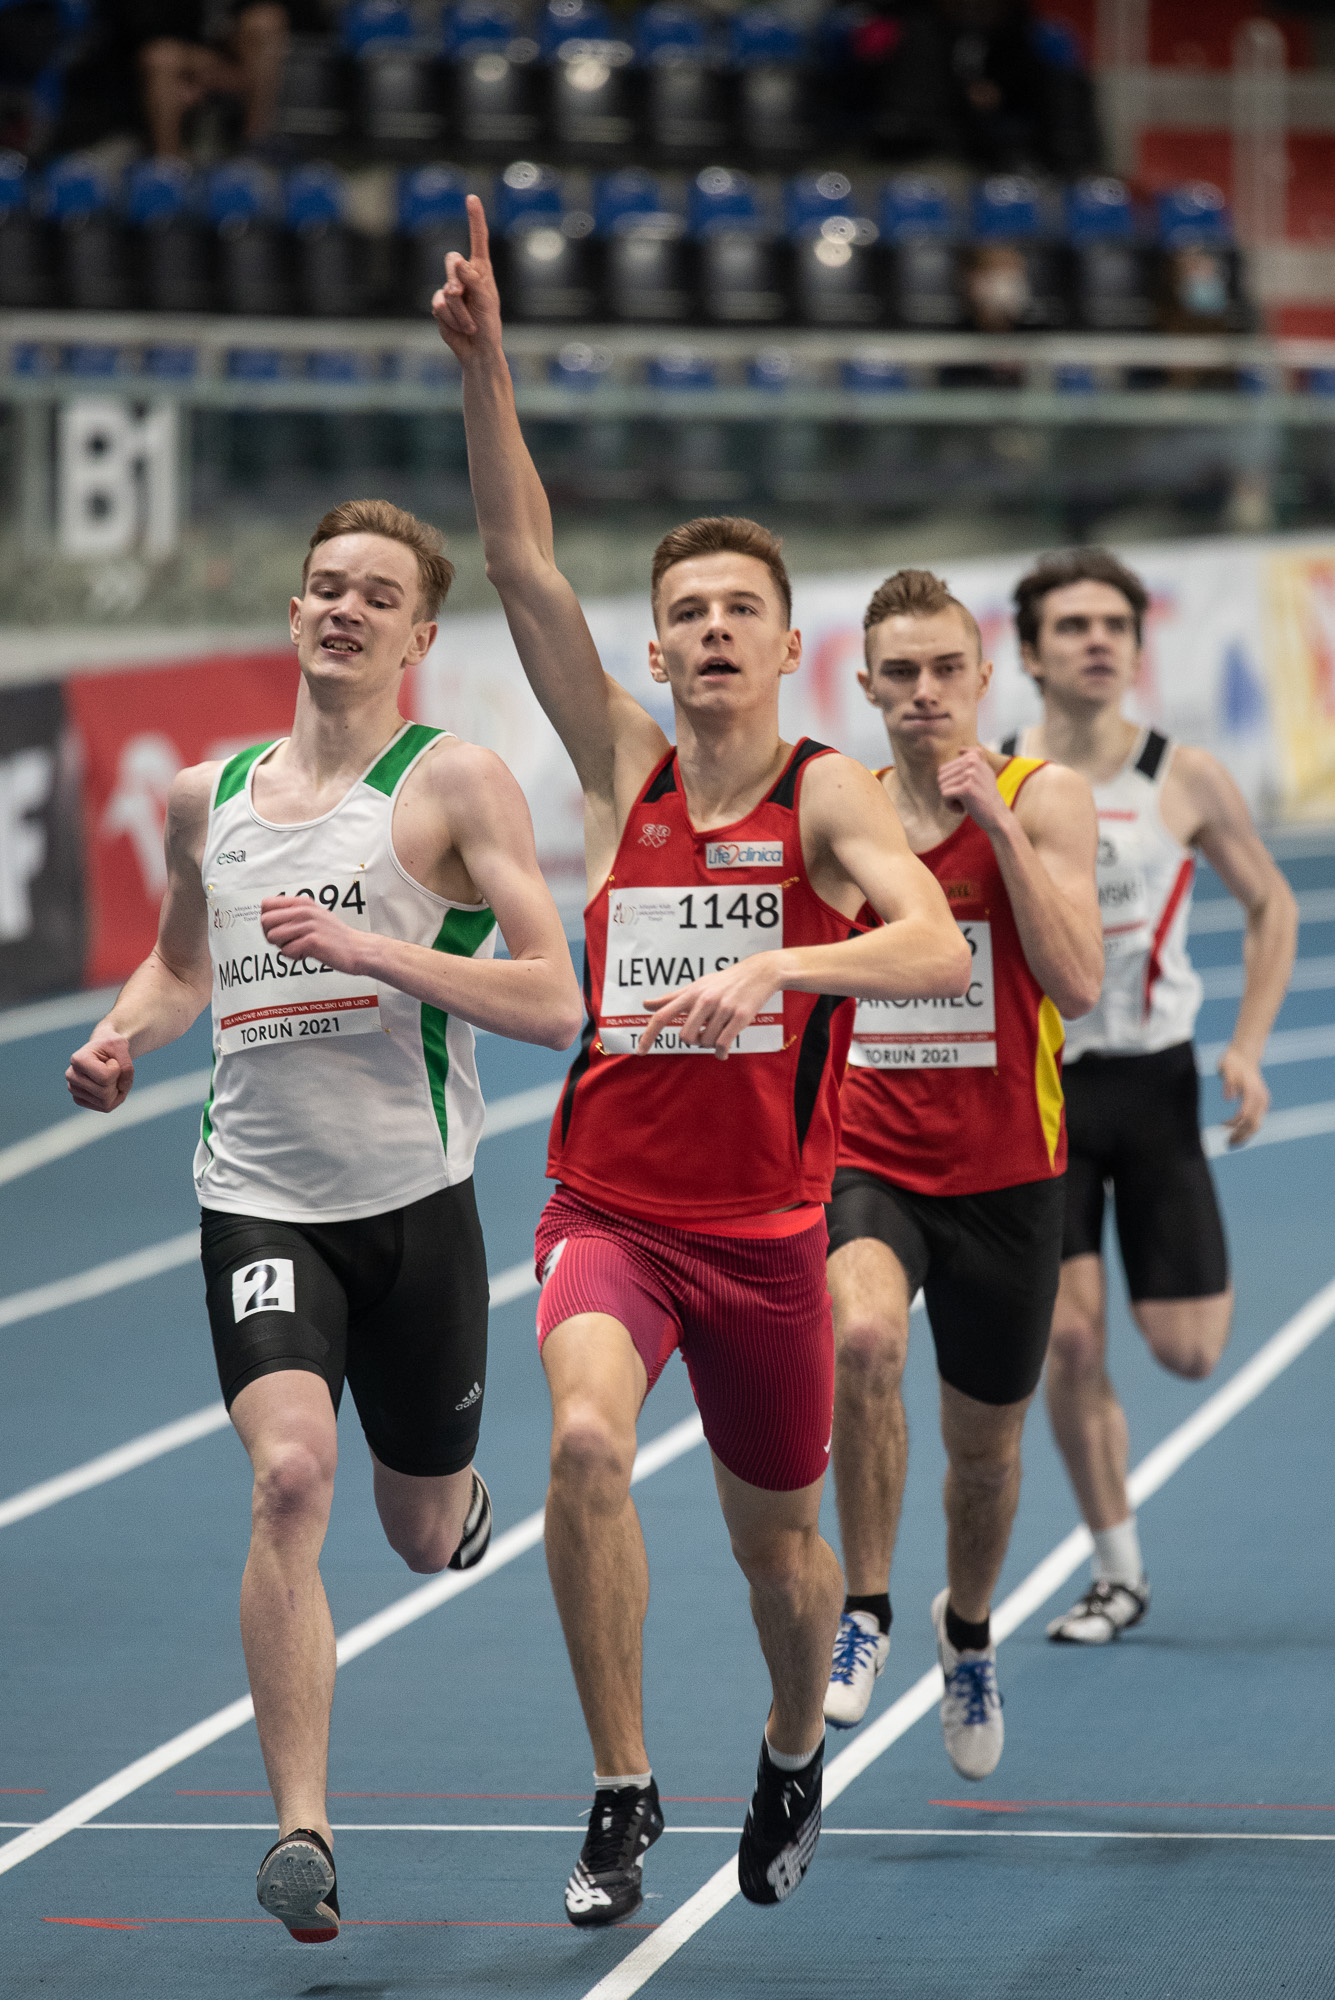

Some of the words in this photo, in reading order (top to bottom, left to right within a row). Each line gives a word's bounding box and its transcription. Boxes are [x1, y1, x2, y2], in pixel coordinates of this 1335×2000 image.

[60, 398, 178, 556] B1
[708, 847, 731, 864] Life
[275, 881, 366, 915] 94
[679, 892, 780, 929] 1148
[619, 957, 739, 987] LEWALS
[309, 1001, 338, 1010] POLSKI
[241, 1018, 292, 1044] TORUŃ
[298, 1017, 340, 1036] 2021
[631, 1033, 690, 1049] TRU
[921, 1049, 958, 1063] 2021
[244, 1264, 279, 1313] 2
